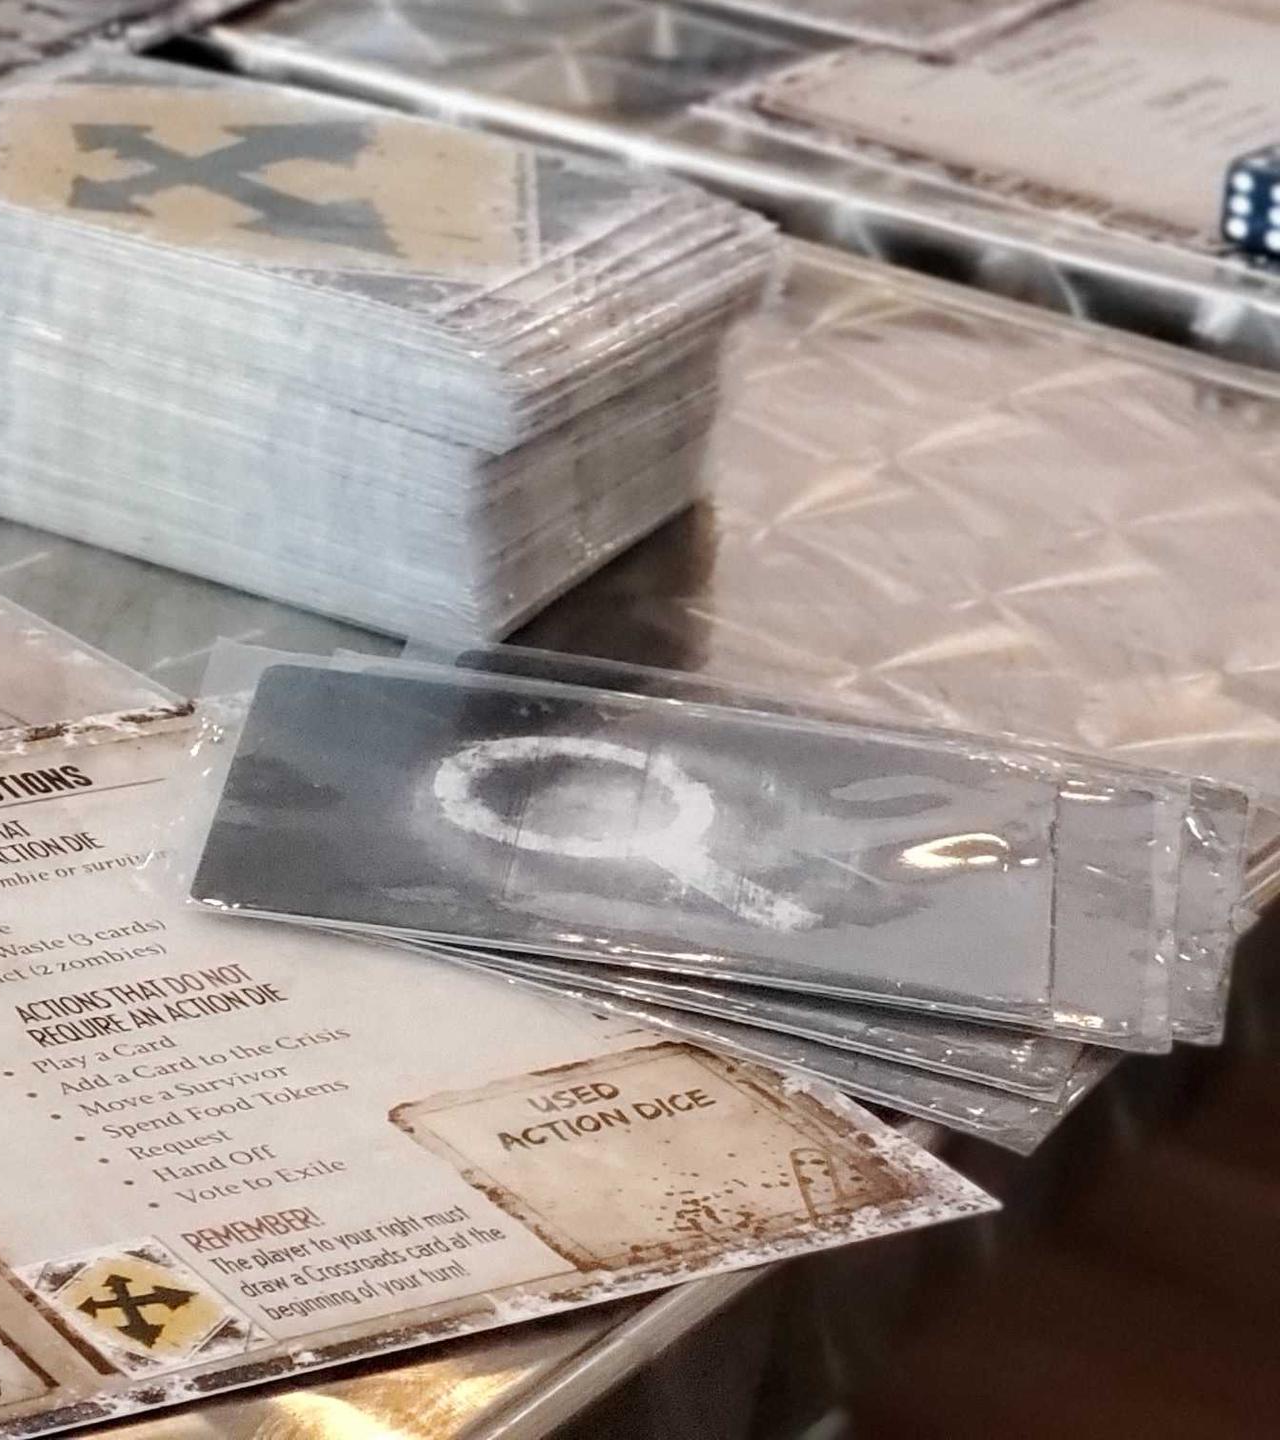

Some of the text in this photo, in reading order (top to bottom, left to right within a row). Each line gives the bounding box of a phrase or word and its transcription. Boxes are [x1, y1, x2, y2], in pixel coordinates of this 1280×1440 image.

[59, 831, 105, 851] DIE
[55, 865, 77, 878] or
[94, 919, 167, 942] cards)
[29, 962, 53, 977] (2
[55, 942, 168, 973] zombies)
[15, 963, 253, 1024] ACTIONS THAT DO NOT
[26, 983, 289, 1048] REQUIRE AN ACTION DIE
[33, 1053, 88, 1073] Play
[114, 1035, 178, 1058] Card
[60, 1073, 111, 1096] Add
[132, 1056, 197, 1080] Card
[198, 1052, 227, 1064] to
[230, 1040, 274, 1059] the
[275, 1026, 352, 1051] Crisis
[78, 1093, 154, 1117] Move
[175, 1064, 290, 1097] Survivor
[102, 1077, 351, 1140] Spend Food Tokens
[527, 1082, 620, 1113] USED
[497, 1088, 717, 1151] ACTION DICE
[127, 1129, 233, 1160] Request
[152, 1144, 278, 1182] Hand Off
[174, 1159, 348, 1206] Vote to Exile
[181, 1207, 325, 1253] REMEMBER!
[209, 1205, 473, 1276] The player to your right must
[239, 1276, 291, 1297] draw
[302, 1250, 408, 1282] Crossroads
[405, 1238, 452, 1258] card
[450, 1233, 473, 1249] at
[468, 1226, 506, 1243] the
[259, 1261, 468, 1320] beginning of your turn!
